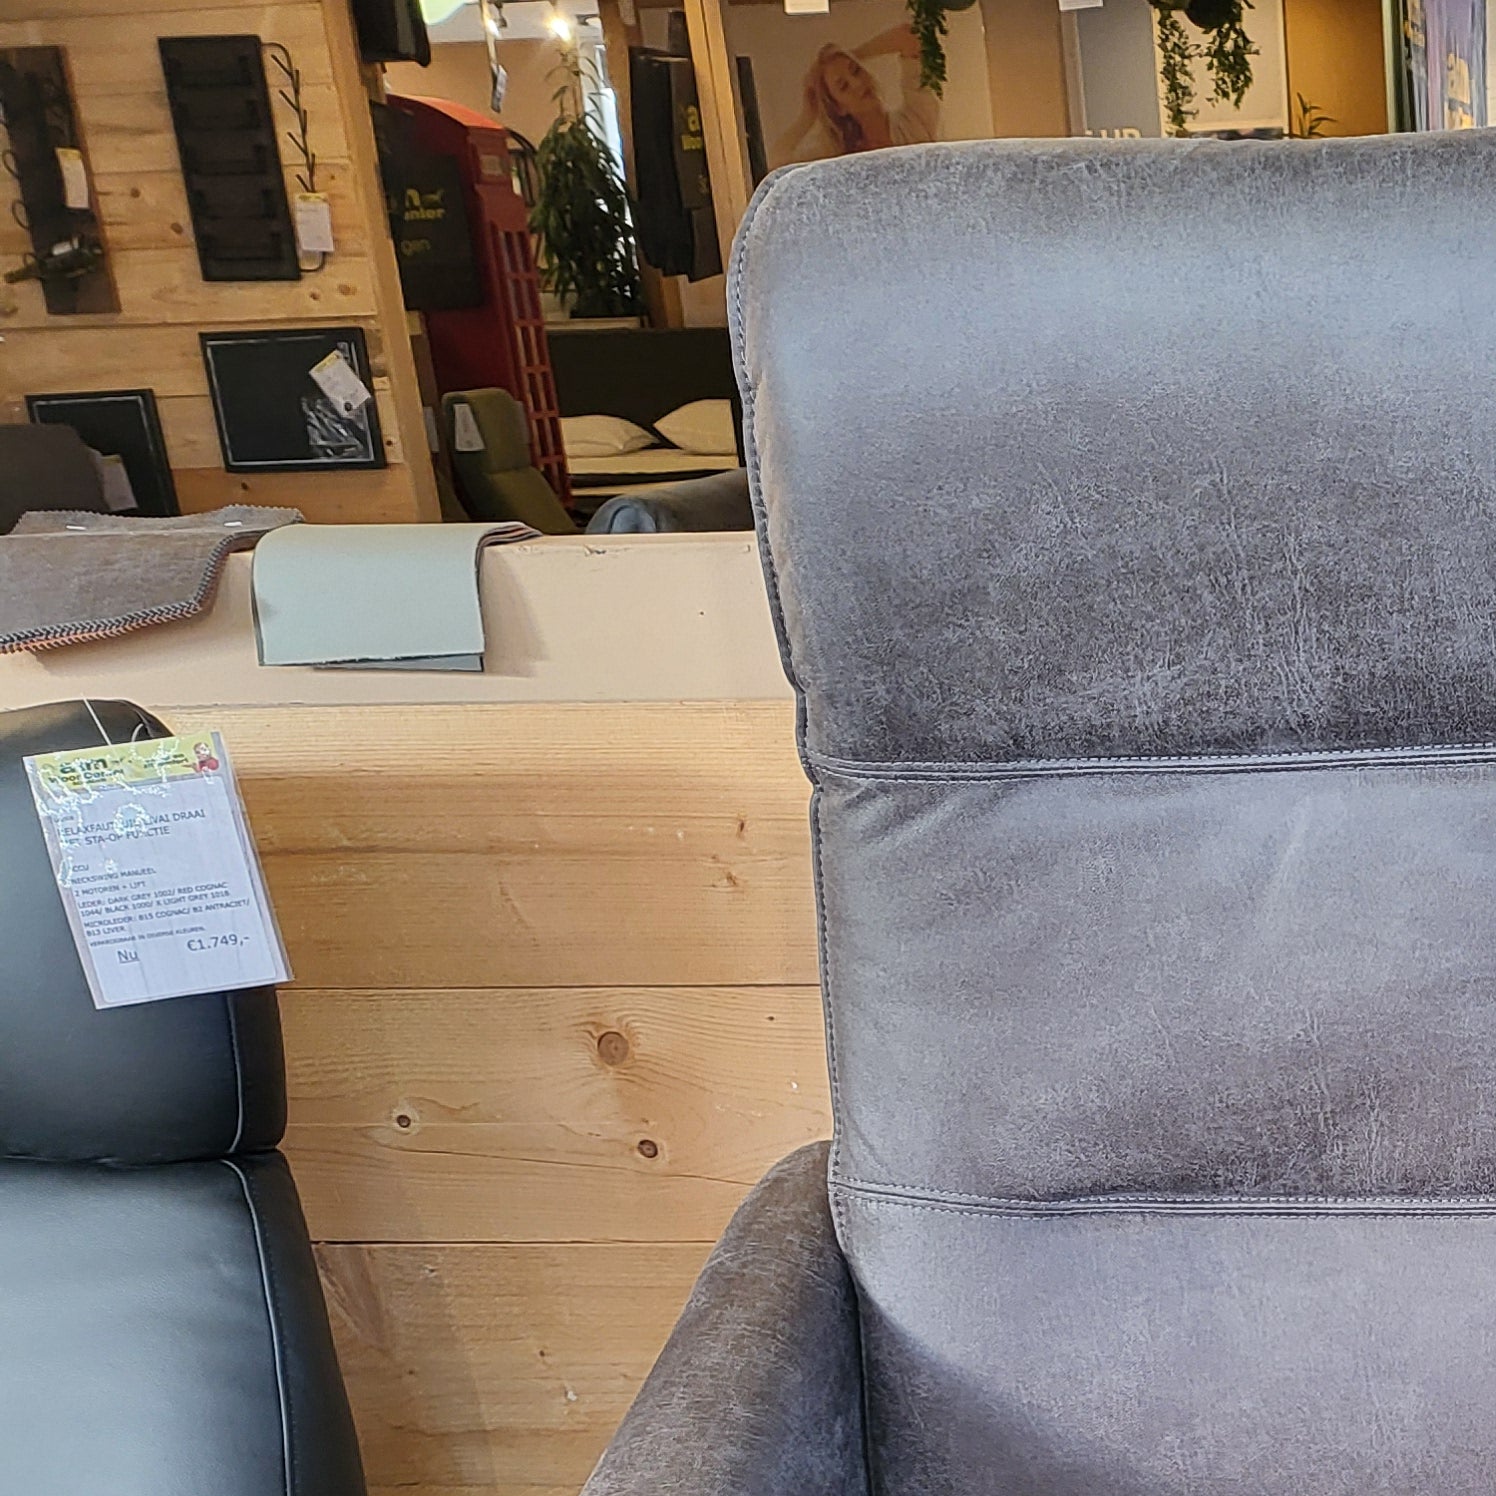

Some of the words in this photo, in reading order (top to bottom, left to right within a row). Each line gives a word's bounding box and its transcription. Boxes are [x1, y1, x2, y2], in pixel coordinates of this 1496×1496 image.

[172, 809, 206, 821] DRAAI
[107, 895, 128, 904] DARK
[131, 892, 151, 901] GREY
[177, 886, 194, 894] RED
[195, 881, 229, 892] COGNAC
[105, 904, 130, 914] BLACK
[163, 896, 187, 905] LIGHT
[188, 893, 208, 902] GREY
[187, 933, 250, 951] €1.749,-
[117, 949, 140, 963] Nu
